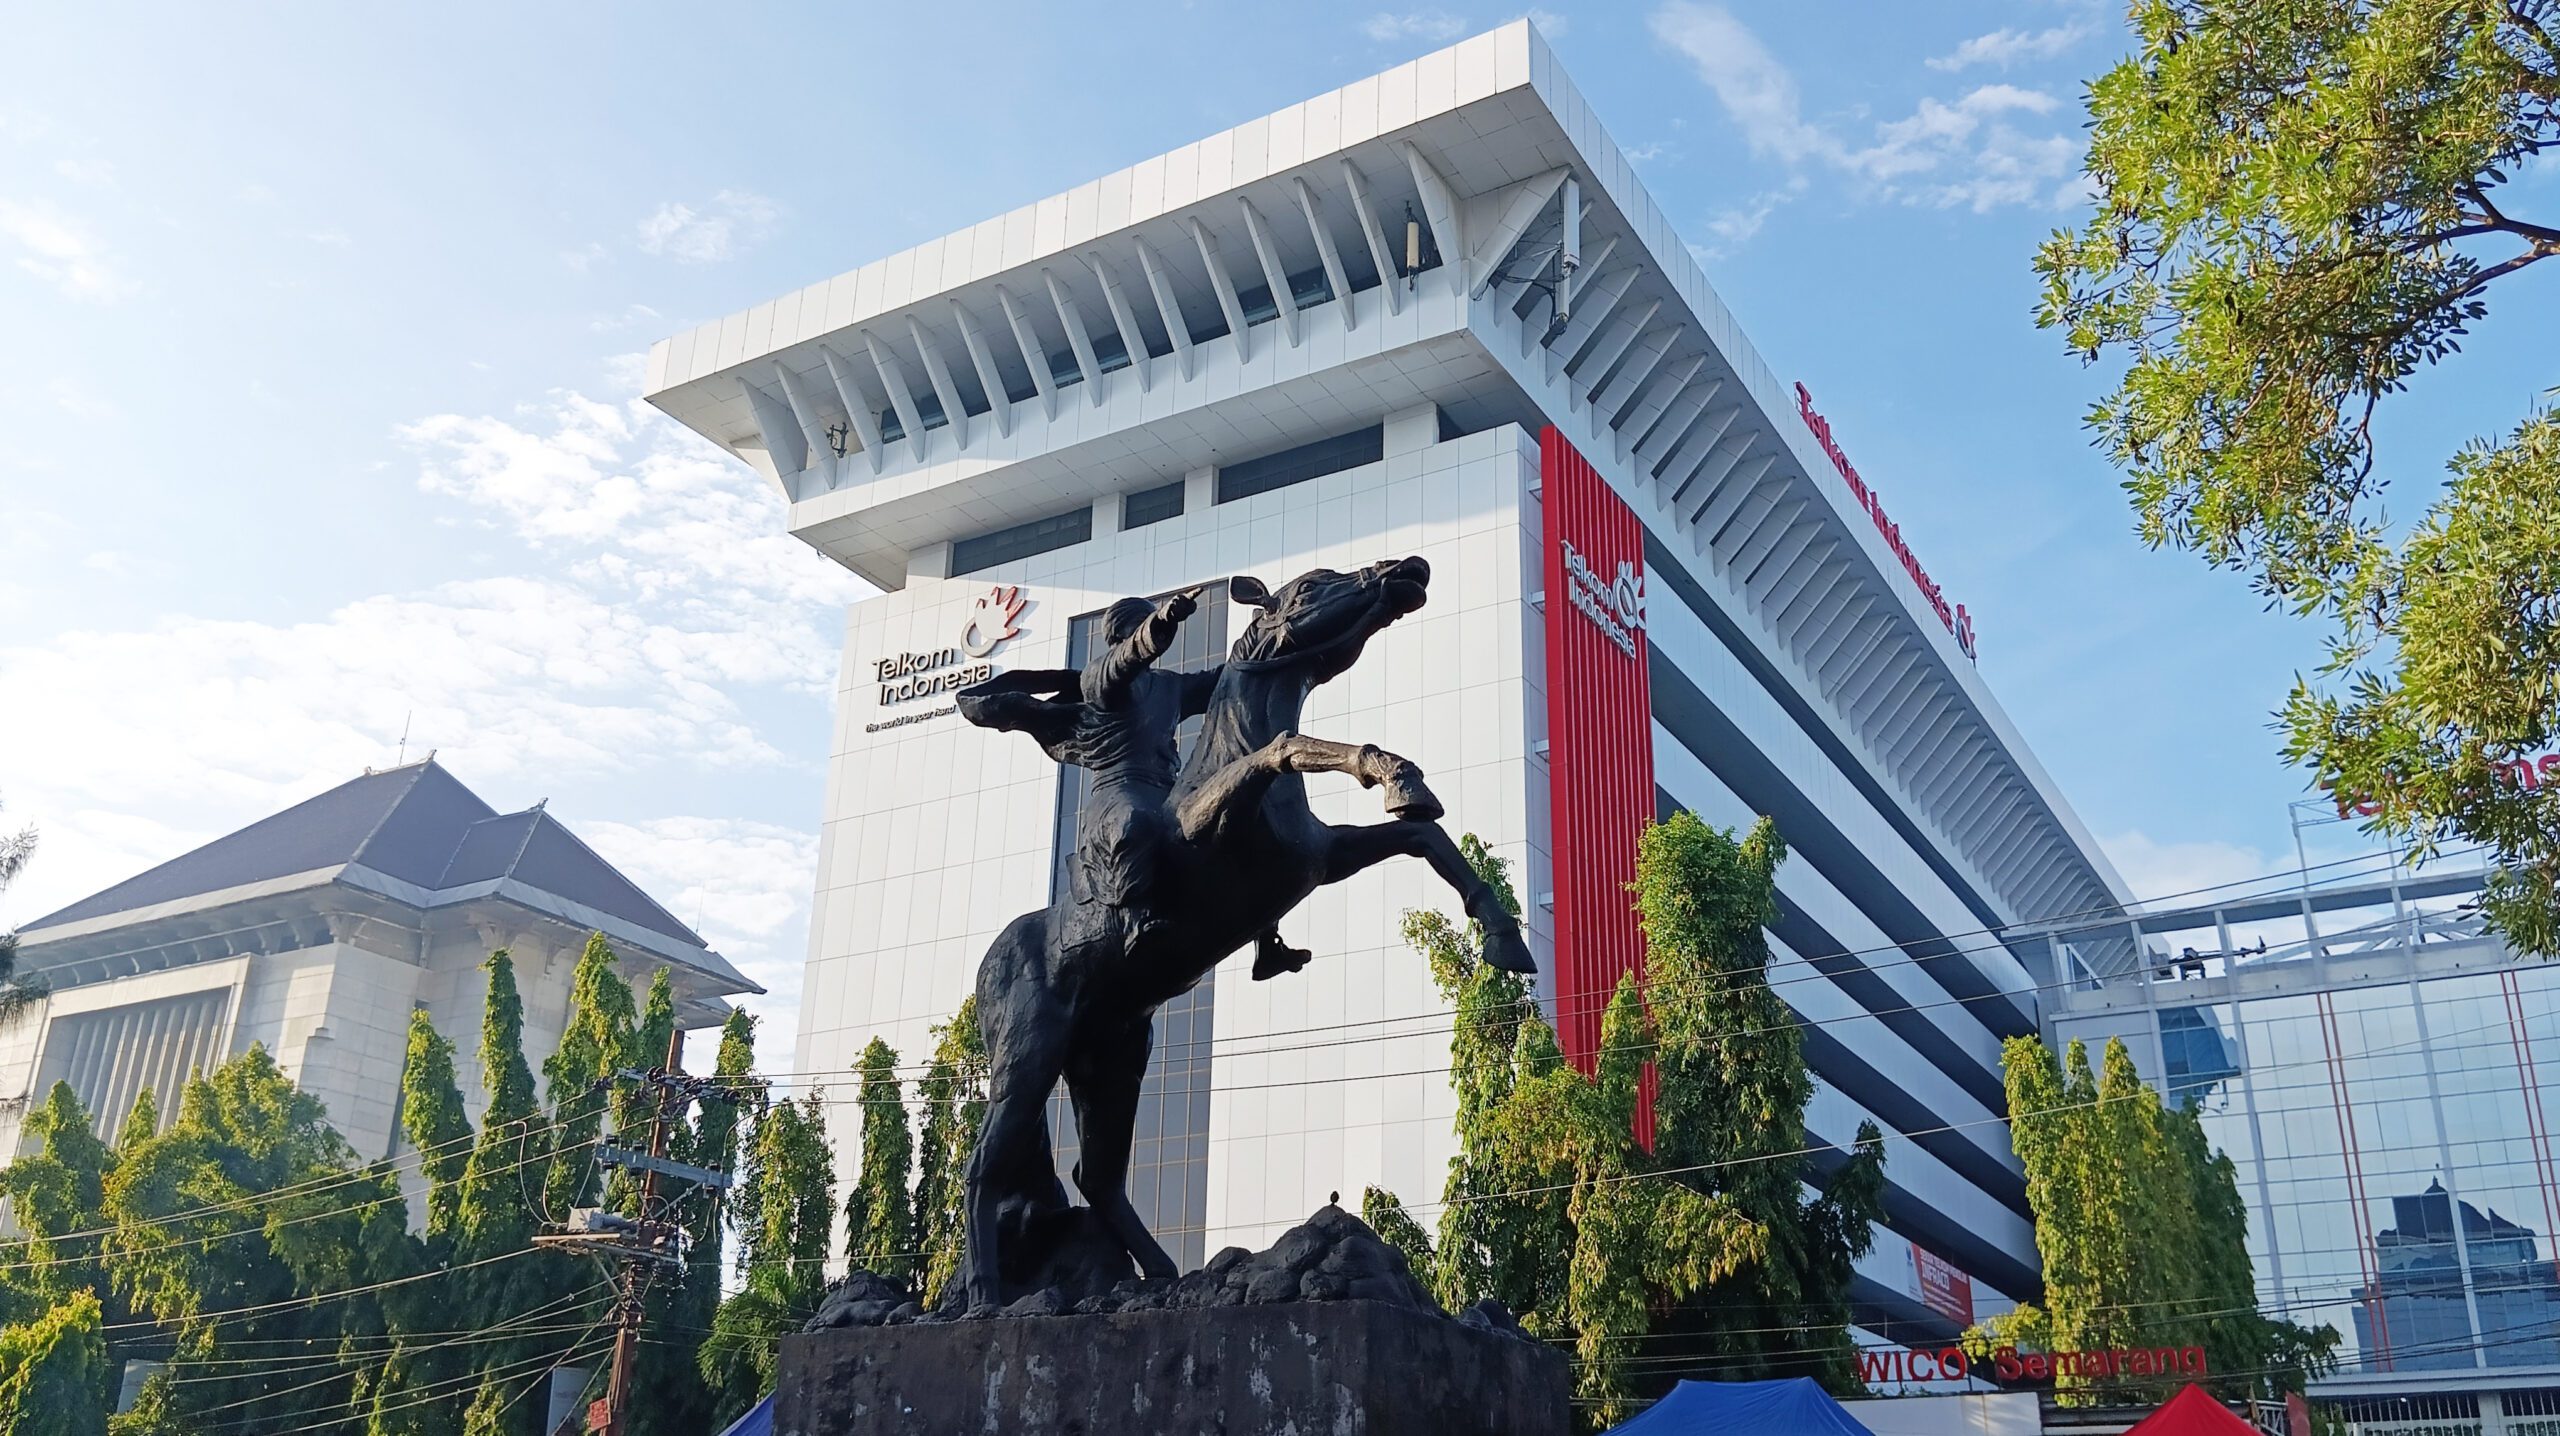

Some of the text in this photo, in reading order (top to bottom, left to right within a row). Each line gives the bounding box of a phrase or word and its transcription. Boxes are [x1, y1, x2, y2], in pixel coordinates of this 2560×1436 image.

[1793, 381, 1955, 637] Telkom Indonesia
[1561, 540, 1614, 610] Telkom
[1568, 576, 1636, 660] Indonesia
[872, 646, 954, 682] Telkom
[879, 663, 992, 706] Indonesia
[881, 716, 904, 730] world
[1996, 1346, 2206, 1380] Semarang
